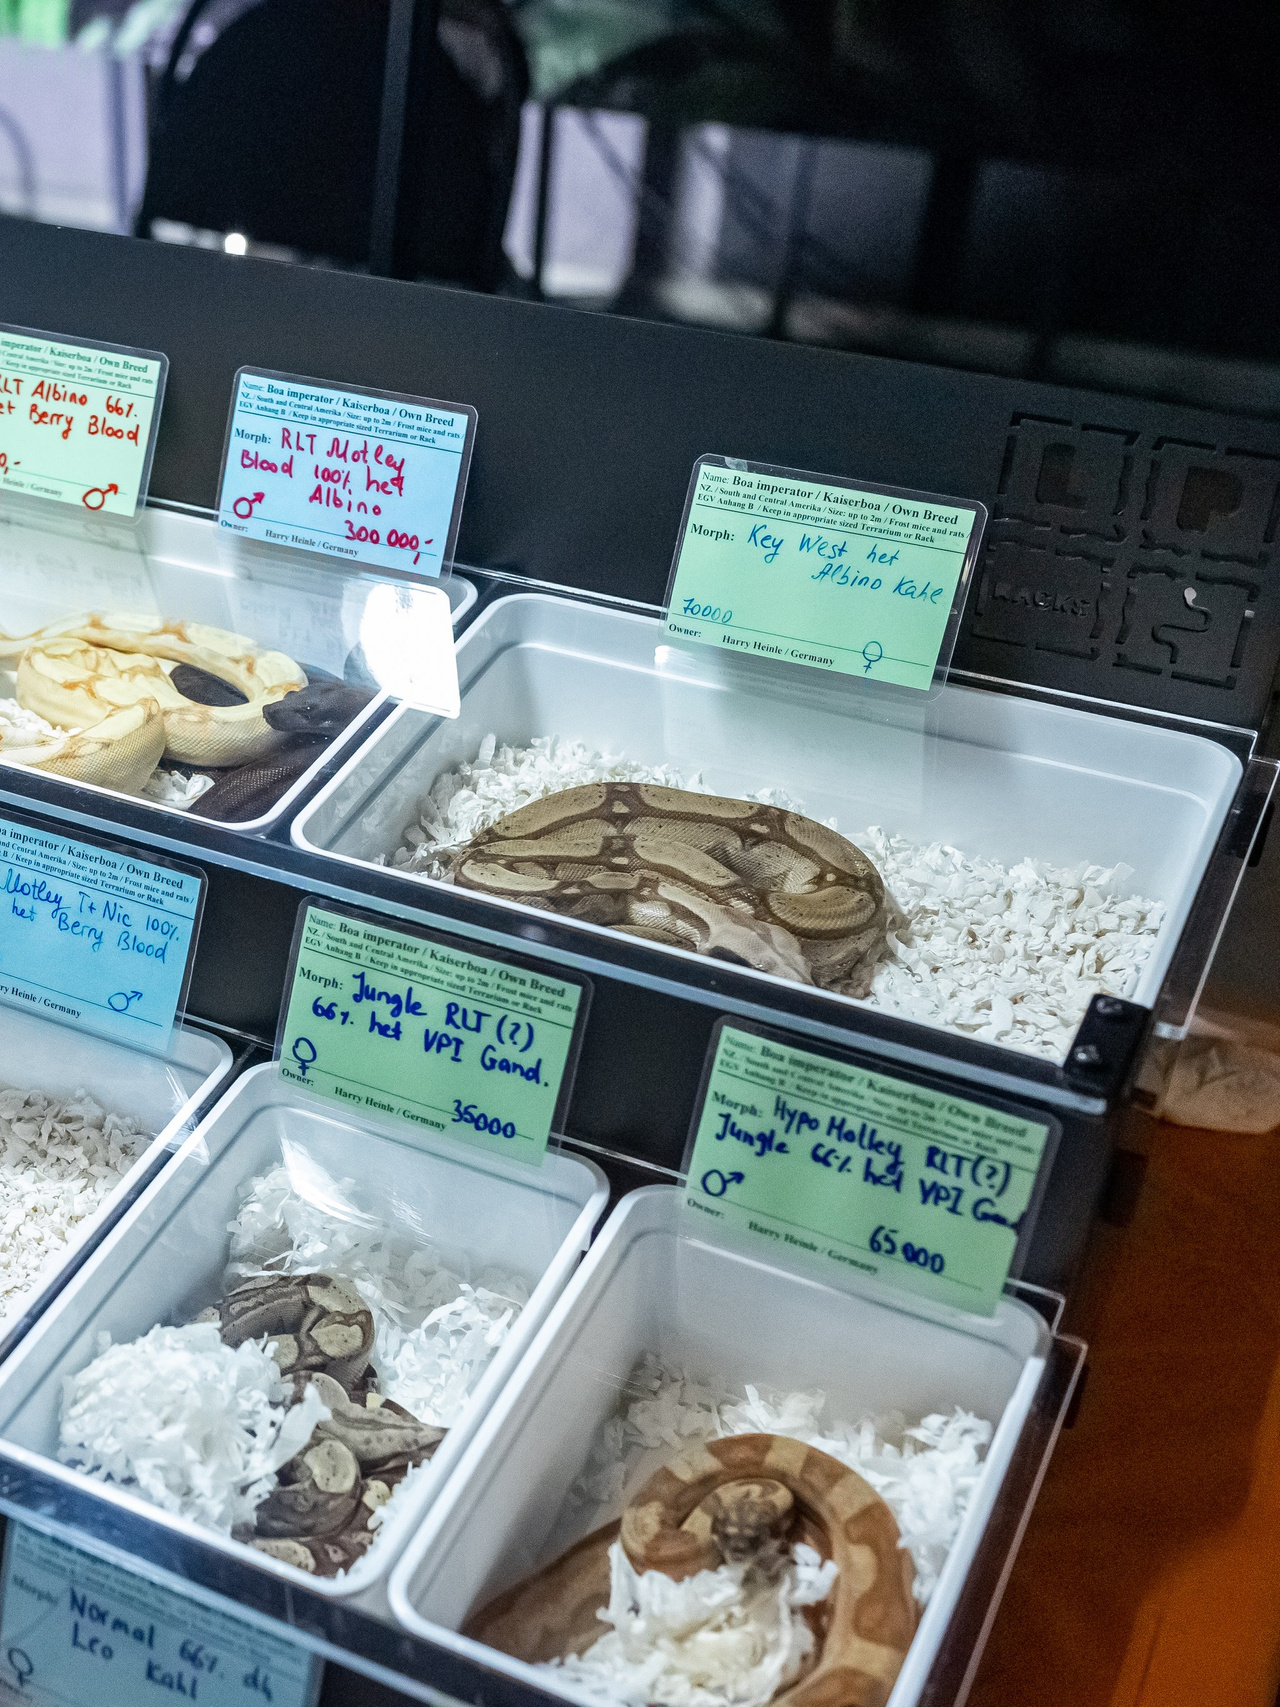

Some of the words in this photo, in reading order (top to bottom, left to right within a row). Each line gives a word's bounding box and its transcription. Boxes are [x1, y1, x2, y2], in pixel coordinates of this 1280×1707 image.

[31, 380, 88, 407] Albino
[29, 403, 74, 440] Berry
[87, 414, 140, 447] Blood
[240, 449, 294, 479] Blood
[366, 465, 405, 497] het
[281, 427, 318, 456] RLT
[326, 437, 406, 478] Motley
[308, 484, 382, 516] Albino
[697, 493, 716, 502] EGV
[716, 497, 745, 510] Anhang
[762, 504, 781, 516] Keep
[782, 508, 791, 516] in
[792, 512, 837, 525] appropriate
[838, 519, 858, 529] sized
[860, 522, 901, 537] Terrarium
[914, 532, 934, 543] Rack
[699, 483, 712, 492] NZ.
[718, 487, 740, 497] South
[758, 494, 787, 505] Central
[787, 500, 821, 512] Amerika
[827, 506, 846, 516] Size:
[847, 512, 858, 520] up
[869, 514, 881, 523] 2m
[888, 517, 909, 528] Frost
[911, 523, 930, 531] mice
[931, 527, 947, 535] and
[948, 530, 964, 538] rats
[702, 471, 729, 484] Name:
[732, 475, 753, 488] Boa
[756, 479, 813, 498] imperator
[822, 491, 880, 511] Kaiserboa
[891, 503, 919, 518] Own
[922, 509, 958, 524] Breed
[690, 522, 734, 541] Morph:
[746, 523, 784, 564] Key
[798, 533, 848, 560] West
[866, 543, 899, 567] het
[811, 563, 883, 591] Albino
[668, 623, 701, 637] Owner:
[722, 634, 750, 649] Harry
[752, 640, 782, 654] Heinle
[790, 649, 834, 667] Germany
[10, 827, 60, 851] imperator
[67, 845, 118, 869] Kaiserboa
[127, 863, 151, 879] Own
[154, 871, 185, 889] Breed
[11, 897, 38, 922] het
[57, 912, 104, 953] Berry
[117, 930, 169, 965] Blood
[78, 891, 97, 914] T+
[102, 900, 133, 928] Nic
[351, 971, 428, 1018] Jungle
[369, 1011, 403, 1041] het
[715, 1112, 790, 1158] Jungle
[772, 1095, 821, 1135] Hypo
[69, 1586, 156, 1649] Normal
[71, 1621, 115, 1661] Leo
